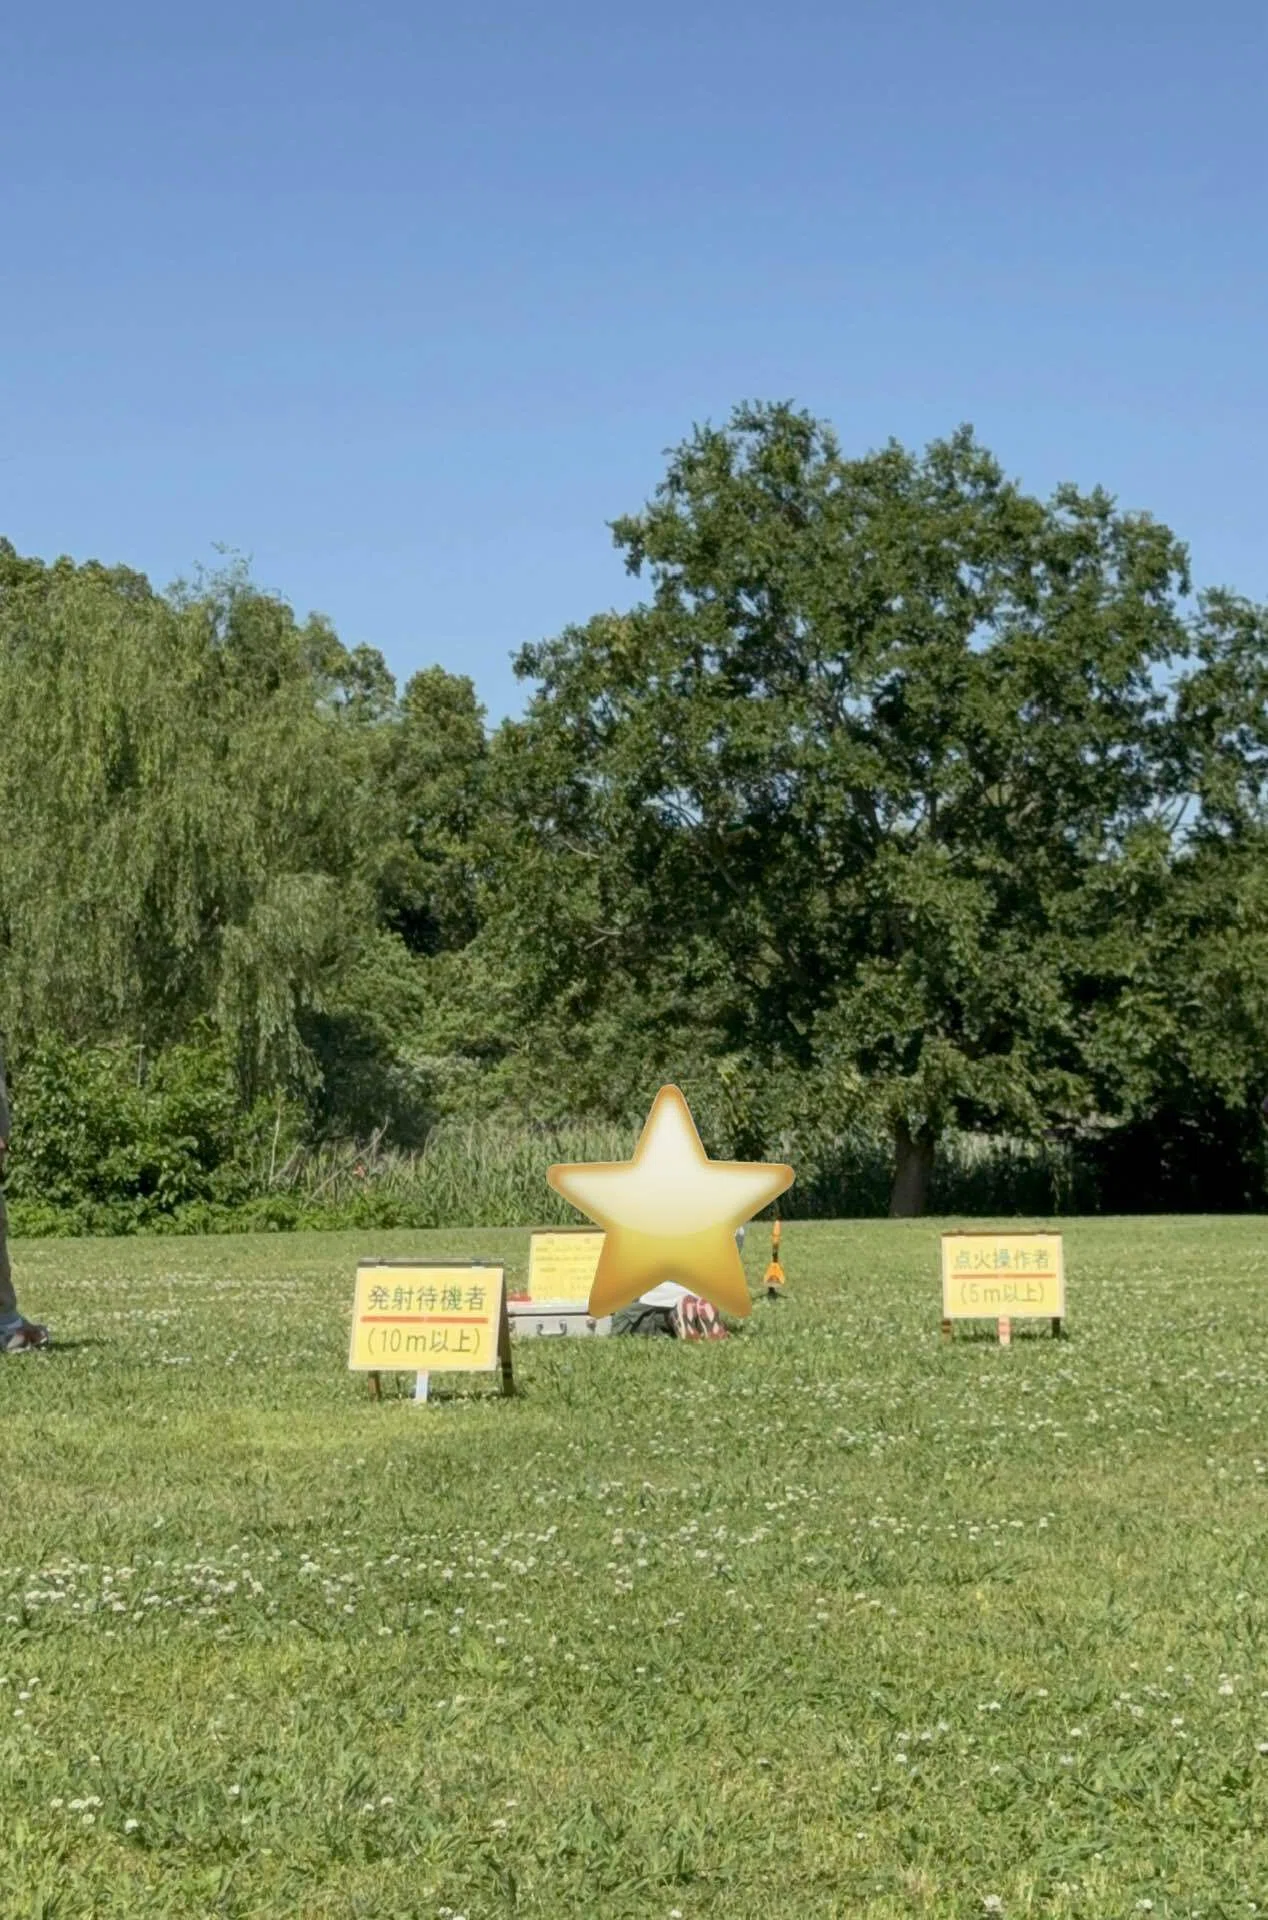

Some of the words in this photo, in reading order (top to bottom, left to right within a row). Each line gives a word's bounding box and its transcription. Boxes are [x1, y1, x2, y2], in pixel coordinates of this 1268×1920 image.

[953, 1248, 1049, 1270] 点火操作者
[367, 1284, 487, 1311] 発射待機者
[367, 1327, 481, 1355] (10m以上)
